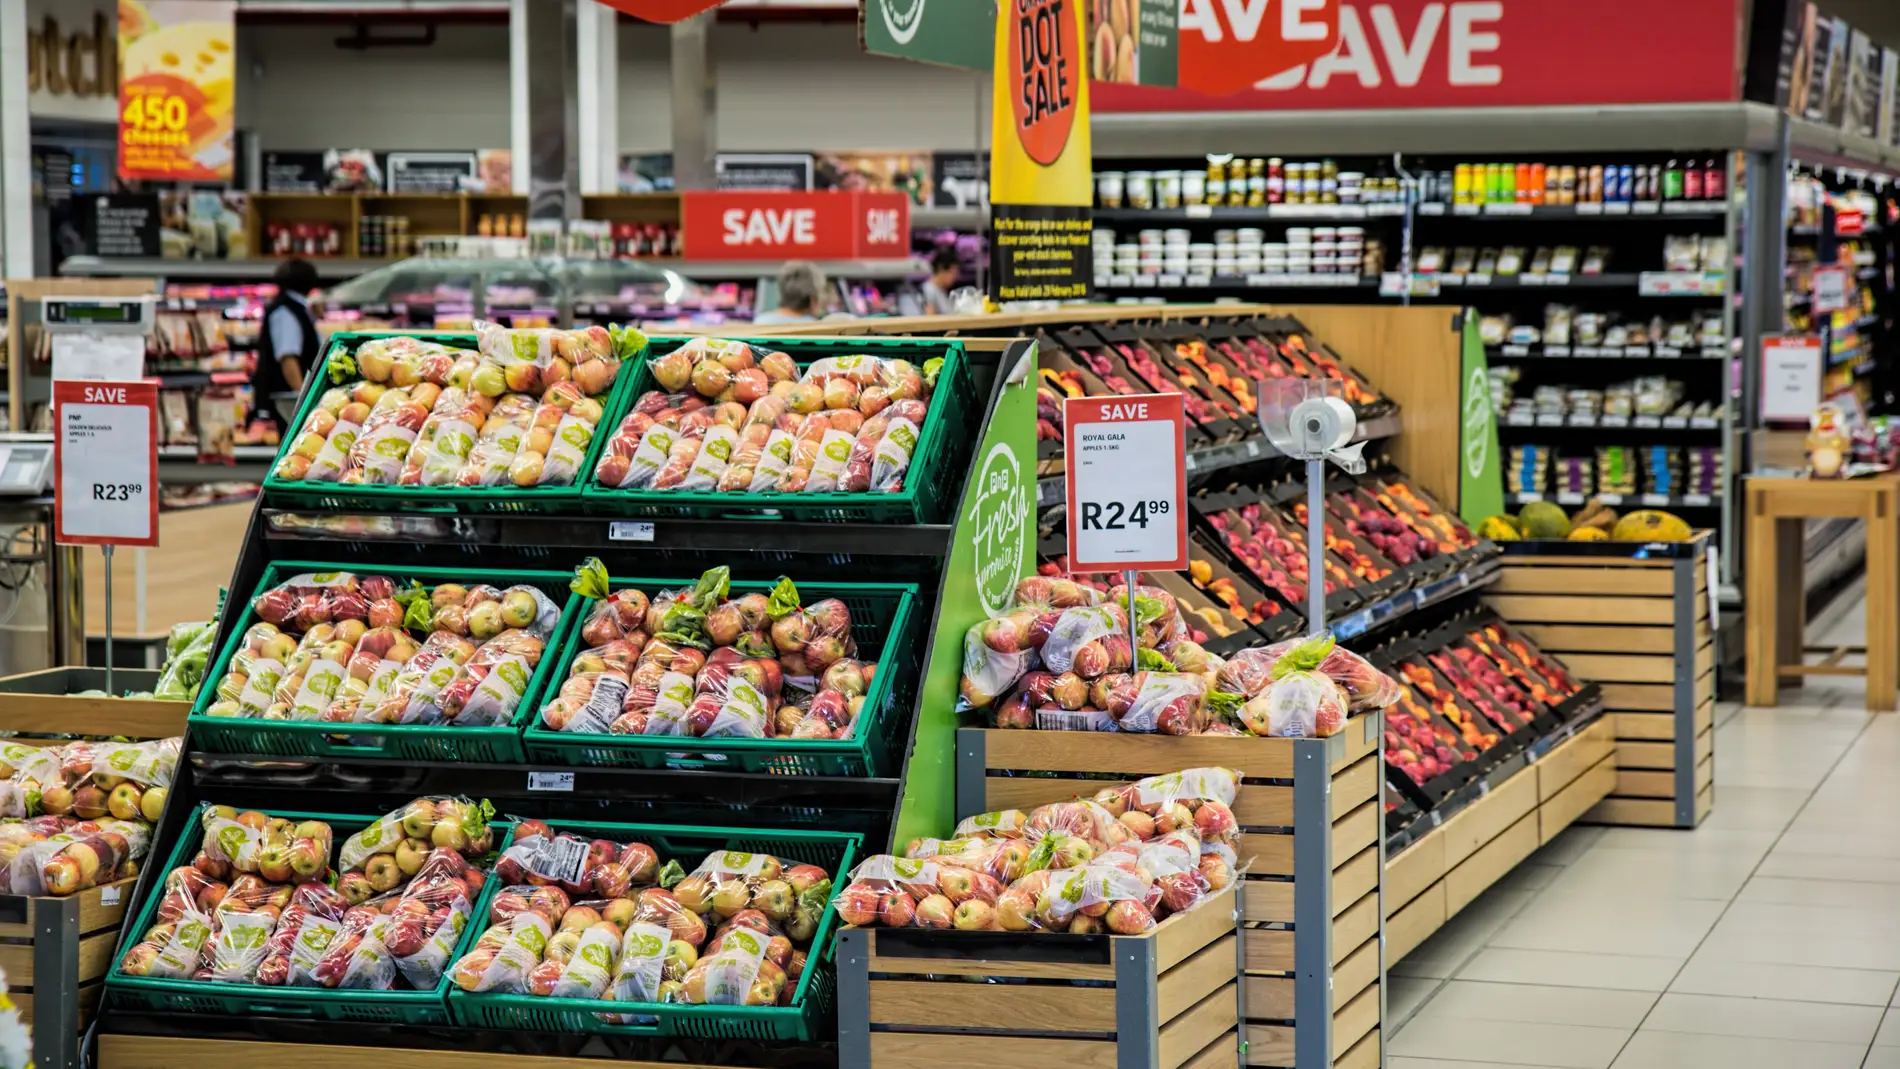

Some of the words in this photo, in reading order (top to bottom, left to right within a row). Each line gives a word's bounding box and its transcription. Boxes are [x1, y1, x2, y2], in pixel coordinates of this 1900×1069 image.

[1020, 1, 1062, 74] DOT
[1179, 0, 1329, 42] AVE
[1253, 2, 1503, 90] AVE
[123, 94, 188, 131] 450
[1022, 58, 1070, 128] SALE
[723, 208, 816, 245] SAVE
[84, 387, 127, 403] SAVE
[1100, 403, 1148, 420] SAVE
[1083, 434, 1106, 442] ROYAL
[1107, 433, 1126, 441] GALA
[969, 461, 1029, 557] Fresh
